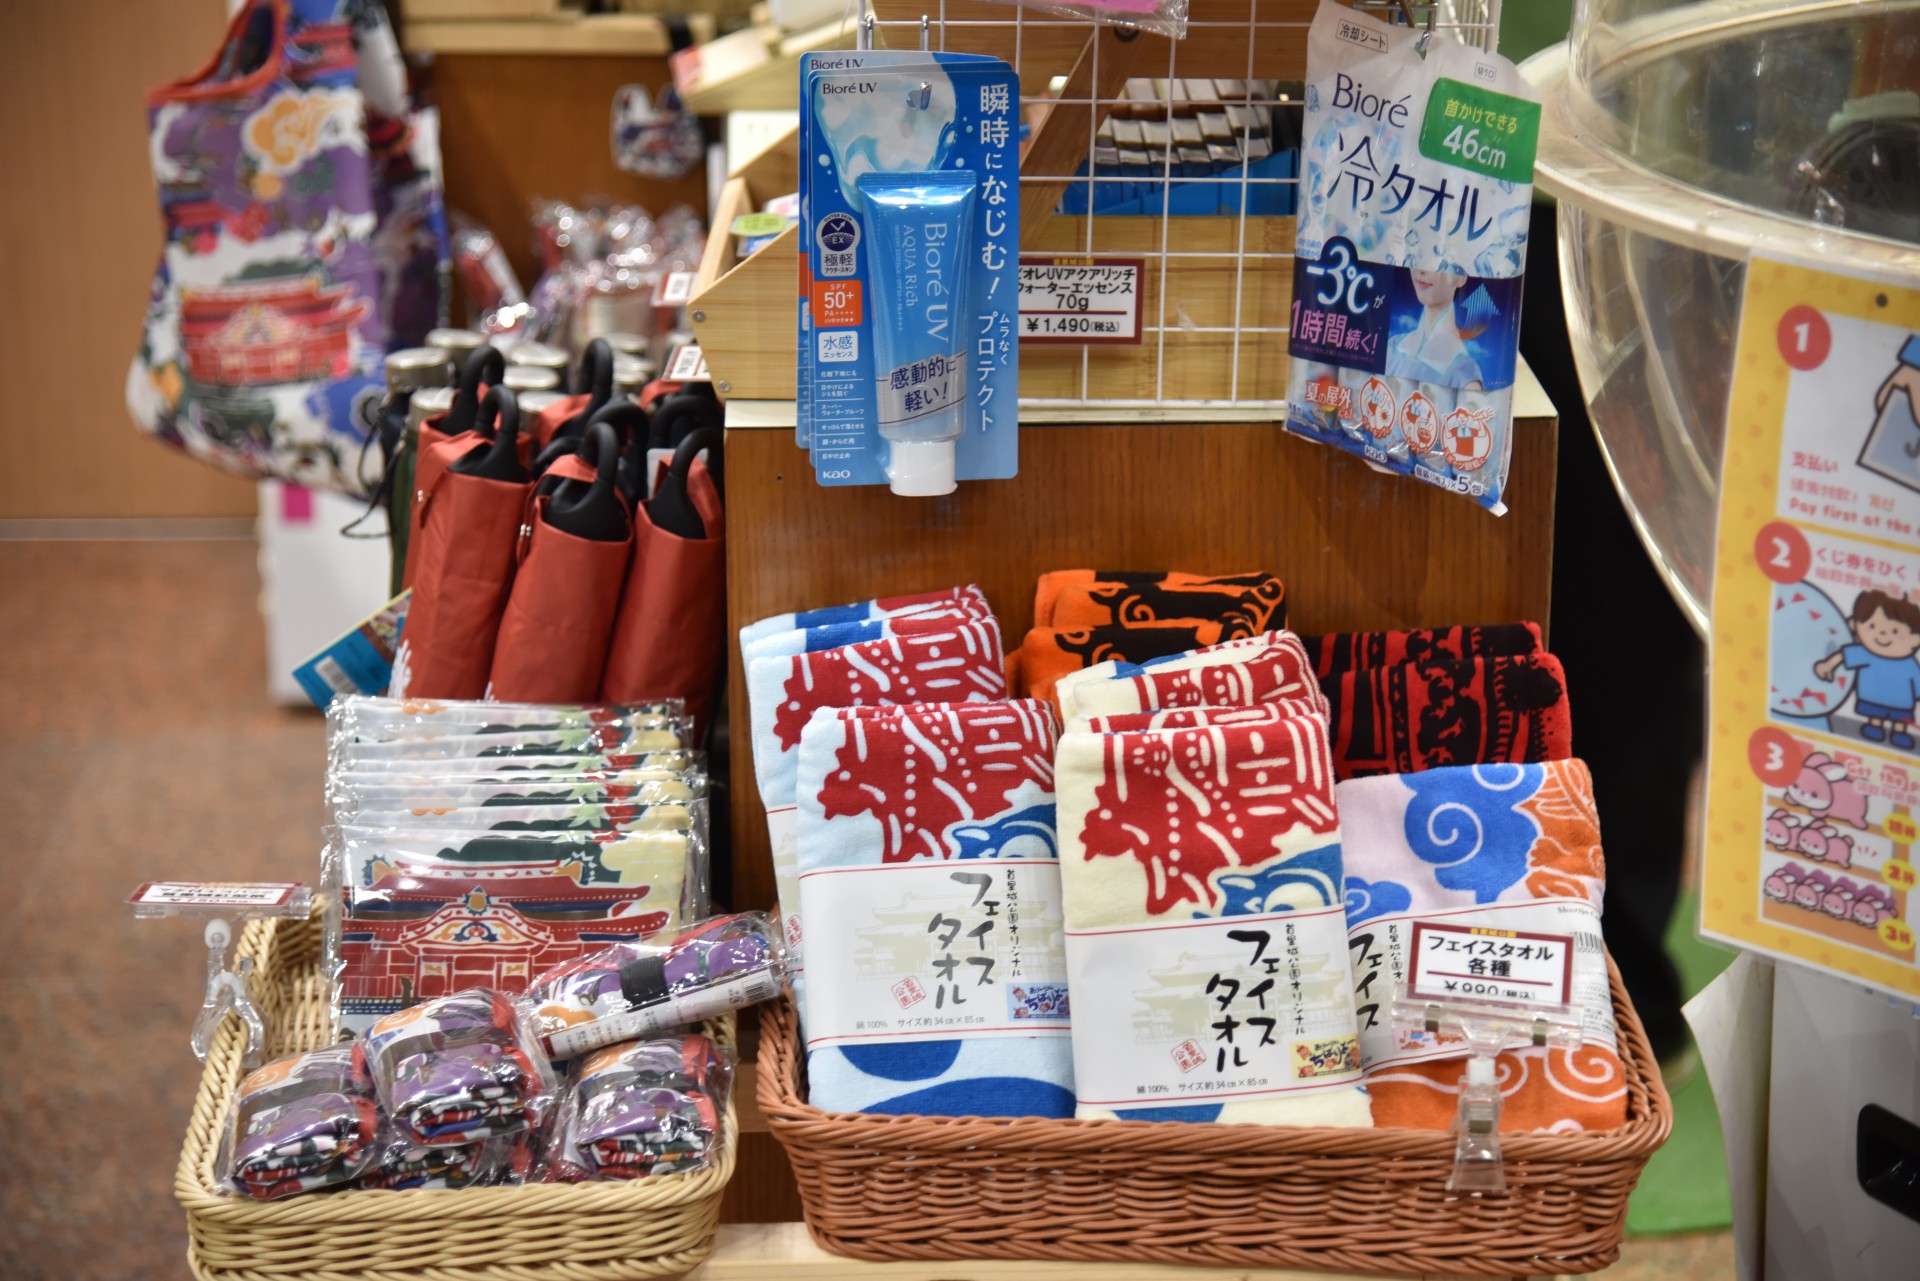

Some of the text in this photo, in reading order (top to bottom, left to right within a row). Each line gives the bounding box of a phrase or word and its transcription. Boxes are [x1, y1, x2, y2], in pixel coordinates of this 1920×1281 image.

[1340, 23, 1386, 48] 冷却シート
[811, 58, 843, 70] Bioré
[823, 82, 878, 95] Bioré UV
[1332, 73, 1411, 128] Bioré
[1444, 99, 1518, 134] 首かけできる
[1442, 125, 1507, 169] 46cm
[980, 83, 1010, 300] 瞬時になじむ！
[1327, 132, 1493, 242] 冷タオル
[832, 236, 845, 244] EX
[824, 254, 853, 267] 極軽
[902, 224, 919, 307] AQUA Rich
[830, 283, 847, 291] SPF
[924, 223, 949, 343] Bioré UV
[824, 291, 855, 309] 50+
[1056, 294, 1089, 311] 70g
[823, 336, 853, 350] 水感
[999, 313, 1011, 365] ムラなく
[1793, 322, 1810, 352] 1
[823, 351, 854, 359] エッセンス
[891, 356, 956, 390] 感動的に
[977, 311, 999, 432] プロテクト
[1790, 497, 1817, 516] Pay
[1770, 536, 1791, 568] 2
[1765, 742, 1784, 771] 3
[950, 872, 1000, 986] フェイス
[928, 913, 967, 1009] タオル
[1428, 936, 1554, 960] フェイスタオル
[1468, 957, 1512, 978] 各種
[1227, 930, 1280, 1047] フェイス
[1206, 973, 1249, 1073] タオル
